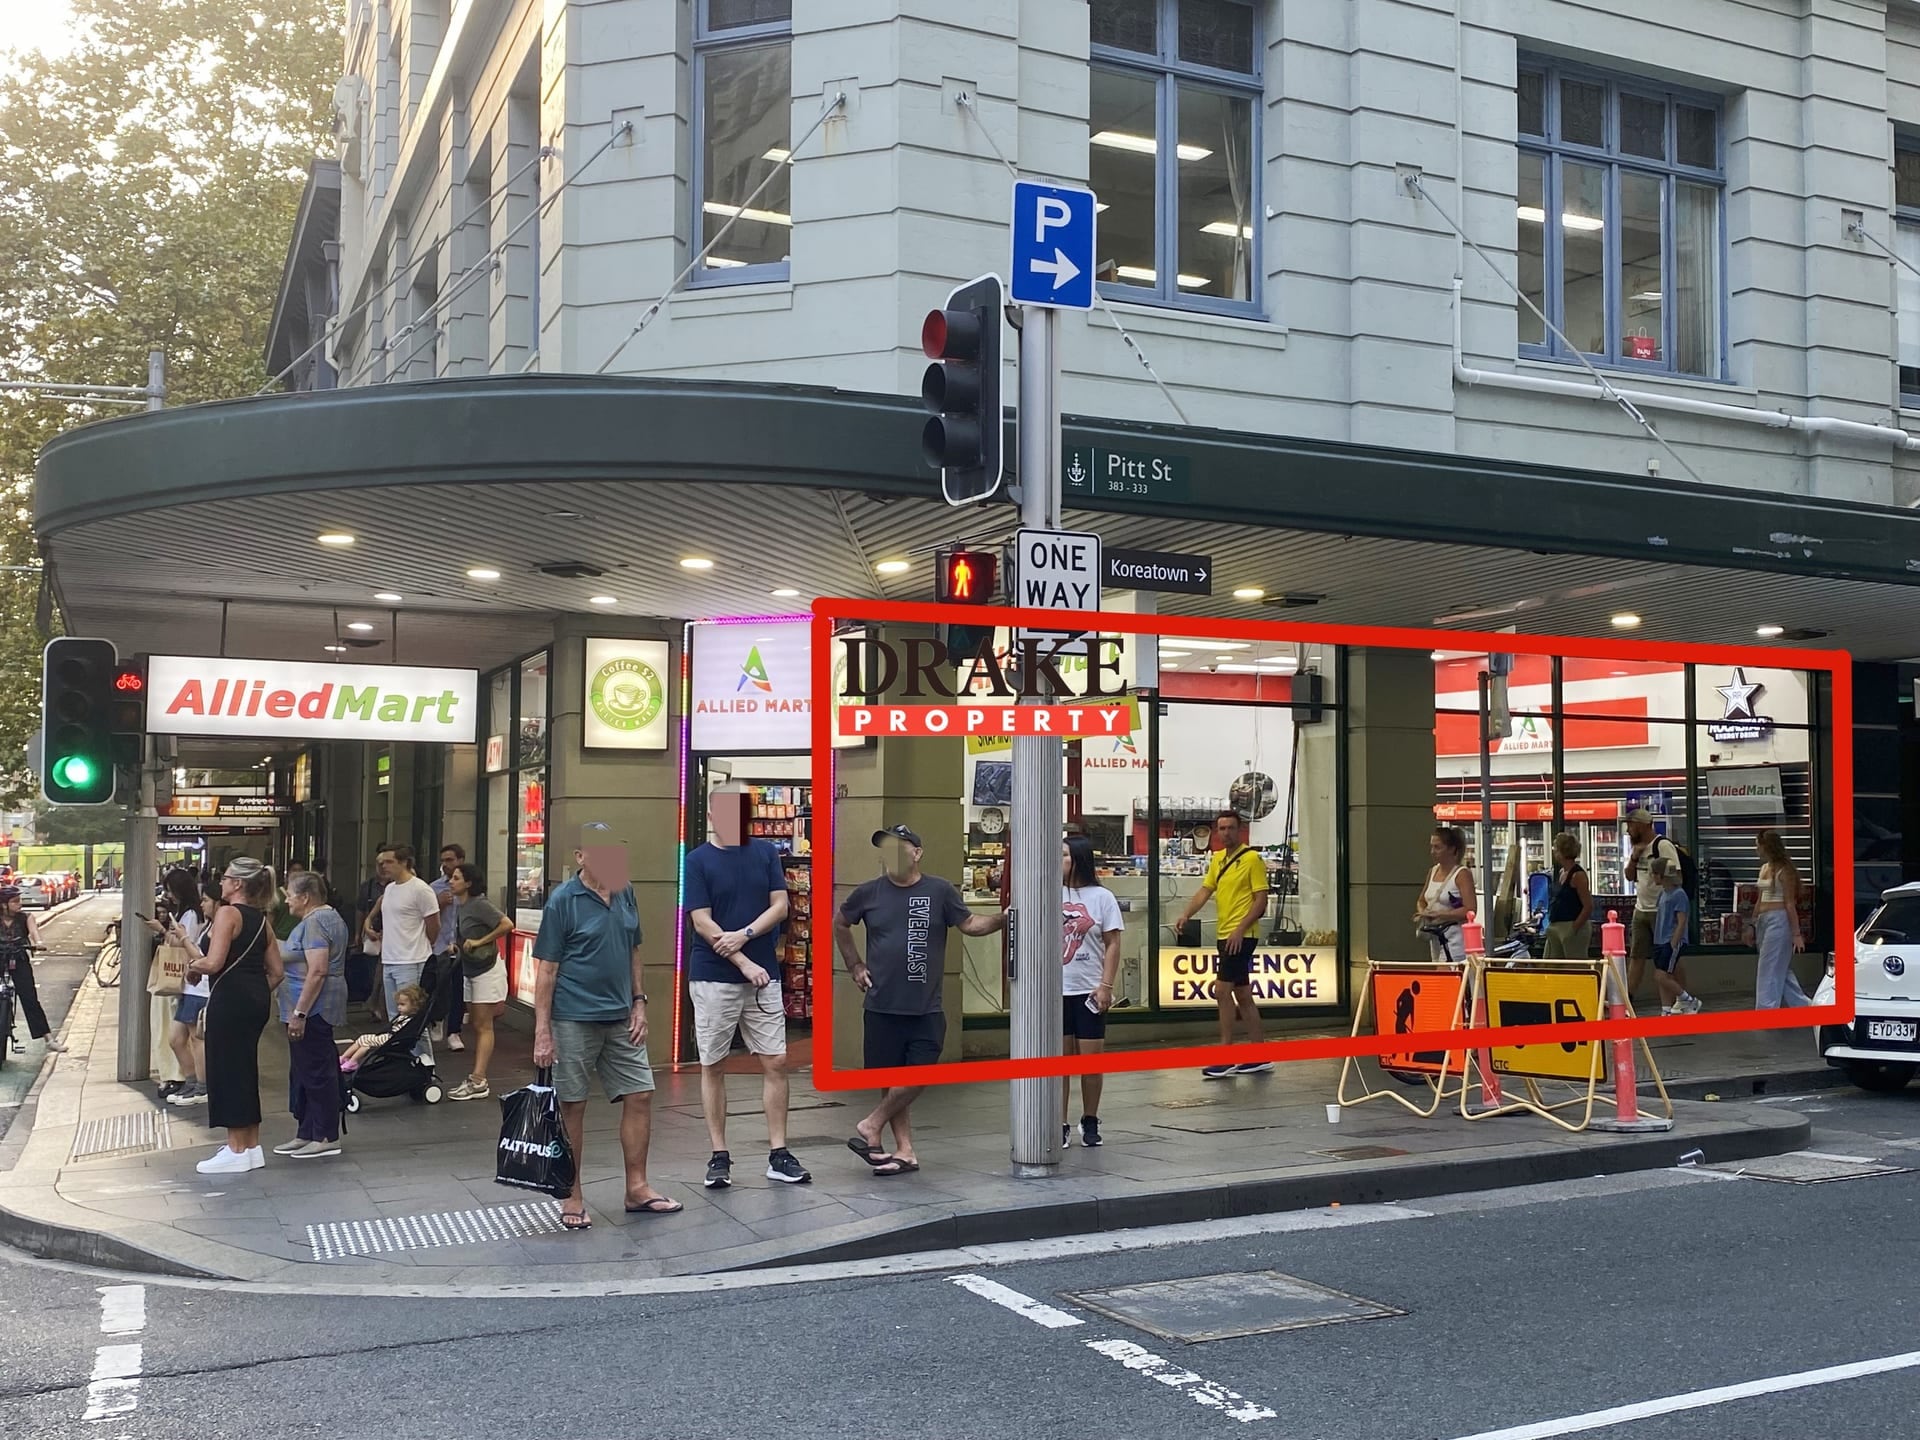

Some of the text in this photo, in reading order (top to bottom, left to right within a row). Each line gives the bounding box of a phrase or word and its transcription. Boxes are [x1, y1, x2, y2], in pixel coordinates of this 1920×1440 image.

[1035, 196, 1072, 243] P
[1108, 454, 1172, 482] Pitt St
[1108, 480, 1124, 492] 383
[1132, 483, 1148, 494] 333
[1030, 542, 1087, 572] ONE
[1111, 559, 1189, 582] Koreatown
[1026, 579, 1091, 610] WAY
[601, 660, 638, 677] Coffee
[166, 678, 459, 724] AlliedMart
[696, 698, 811, 713] ALLIED MART
[1504, 741, 1529, 750] ALLIED
[1084, 758, 1164, 769] ALLIED MAT
[1712, 784, 1776, 797] AlliedMart
[907, 896, 931, 984] EVERLAST
[163, 962, 185, 972] MUJI
[1173, 953, 1316, 975] CURENCY
[1172, 978, 1318, 1001] EXCANGE
[1494, 1060, 1509, 1070] CTC
[500, 1137, 552, 1158] PLATYPUS
